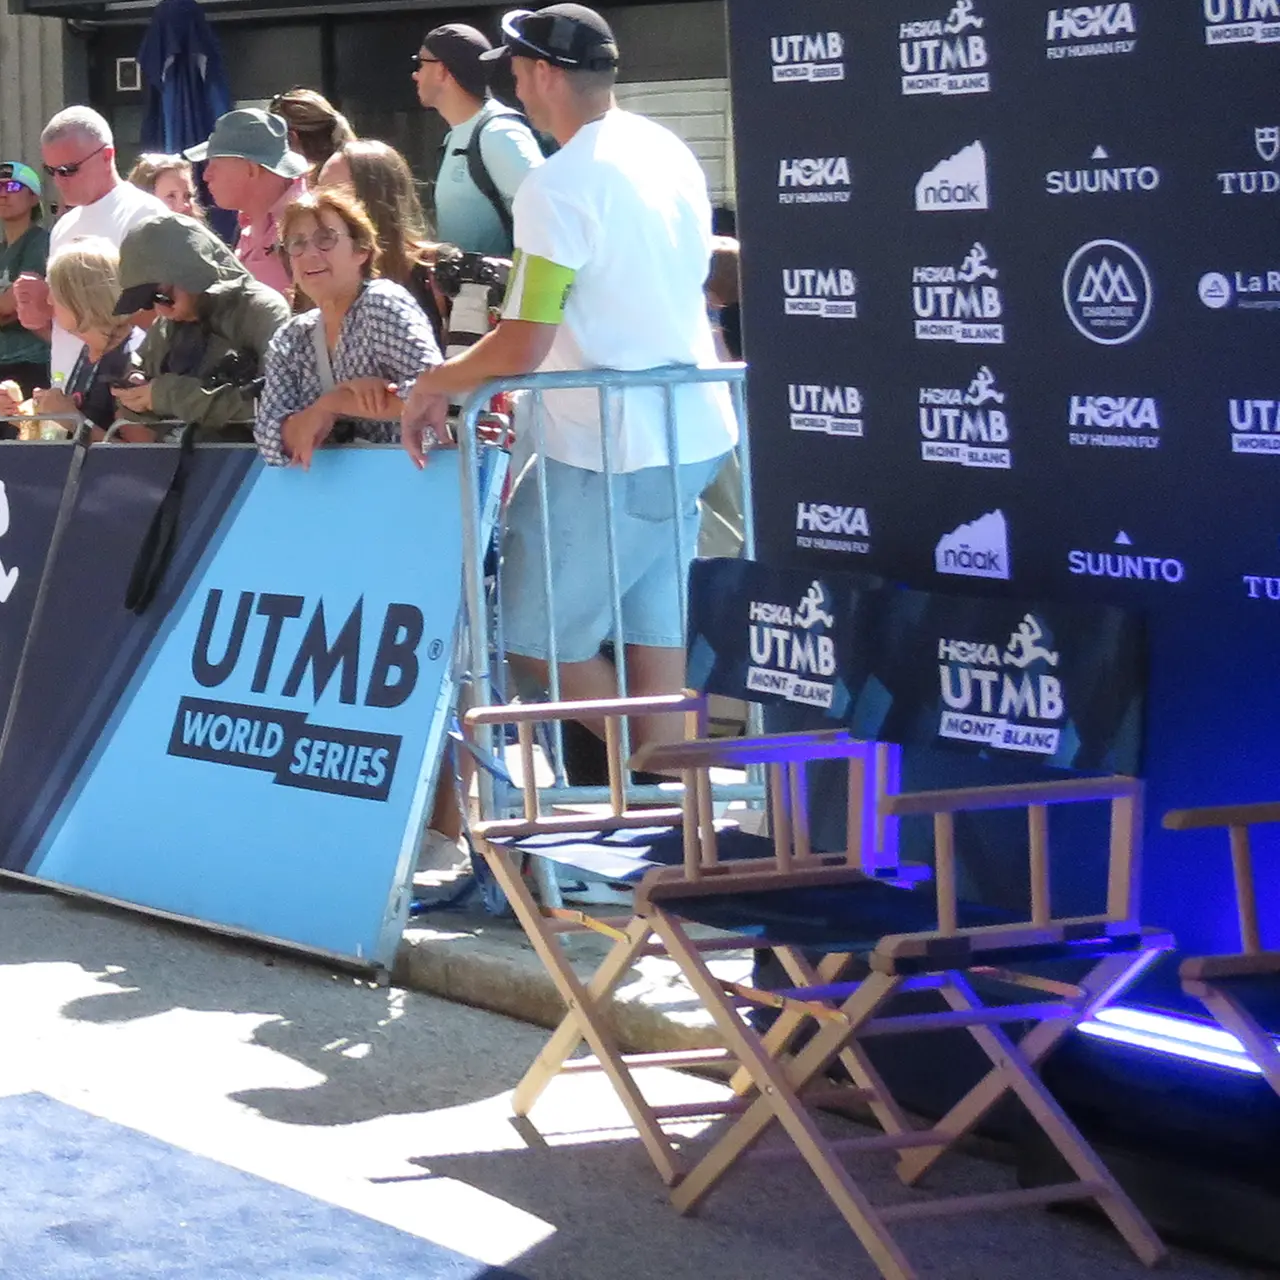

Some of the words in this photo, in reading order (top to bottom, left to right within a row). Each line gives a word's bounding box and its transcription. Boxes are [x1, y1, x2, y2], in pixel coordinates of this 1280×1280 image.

[899, 20, 943, 39] HOKA
[1046, 2, 1136, 40] HOKA
[771, 32, 843, 63] UTMB
[899, 35, 988, 73] UTMB
[778, 156, 851, 187] HOKA
[1045, 166, 1160, 194] SUUNTO
[924, 180, 980, 204] näak
[782, 269, 856, 296] UTMB
[912, 266, 956, 283] HOKA
[1235, 271, 1262, 293] La
[912, 285, 1002, 318] UTMB
[788, 384, 861, 414] UTMB
[919, 388, 963, 405] HOKA
[919, 407, 1009, 442] UTMB
[1068, 396, 1160, 429] HOKA
[1229, 399, 1280, 432] UT
[796, 502, 870, 536] HOKA
[944, 543, 1001, 571] näak
[1068, 550, 1185, 583] SUUNTO
[749, 601, 792, 626] HOKA
[190, 588, 425, 710] UTMB
[749, 625, 836, 676] UTMB
[938, 638, 1002, 666] HOKA
[940, 664, 1063, 720] UTMB
[180, 709, 284, 760] WORLD
[287, 735, 390, 788] SERIES
[946, 717, 1056, 749] MONT-BLANC
